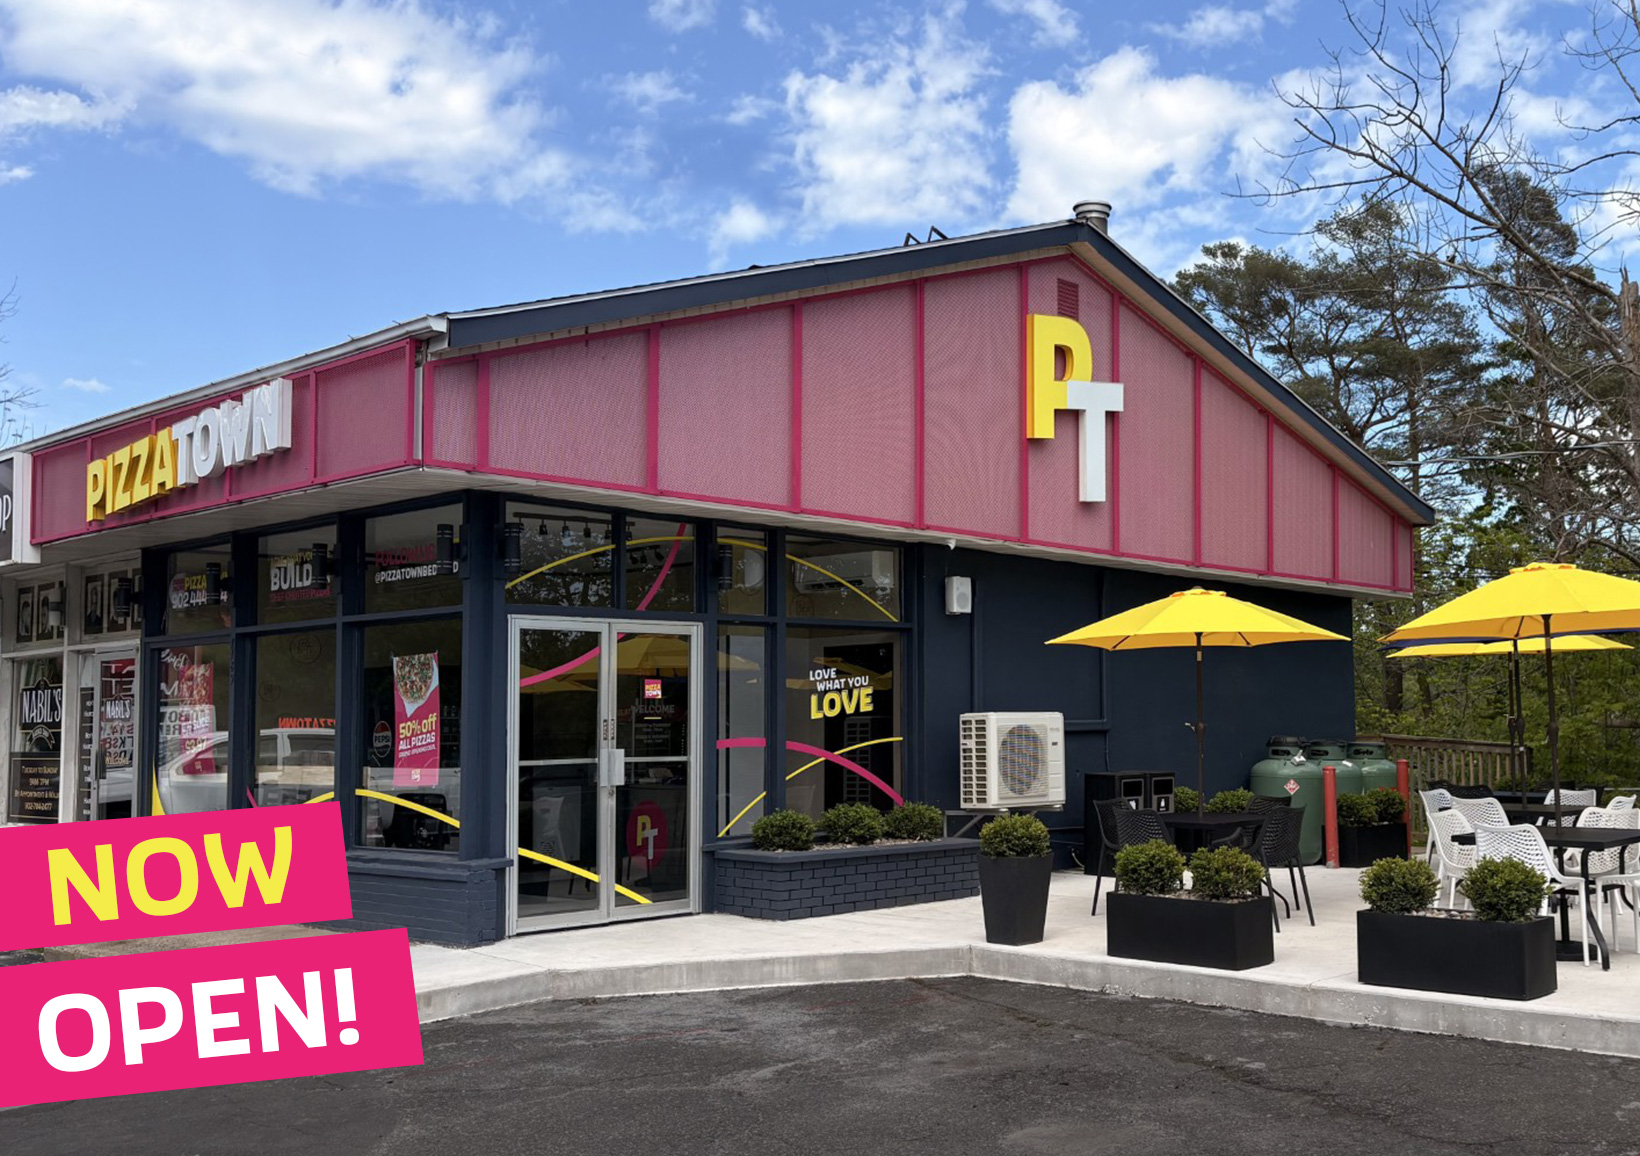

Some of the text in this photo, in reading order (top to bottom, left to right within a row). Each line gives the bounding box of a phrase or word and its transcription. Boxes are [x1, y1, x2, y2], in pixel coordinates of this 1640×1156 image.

[1027, 314, 1124, 502] PT
[270, 563, 312, 592] BUILD
[374, 561, 459, 584] @PIZZATOWNBEDD
[809, 668, 837, 681] LOVE
[816, 675, 869, 691] WHAT YOU
[22, 688, 62, 724] NABIL'S
[631, 704, 675, 714] WELCOME
[811, 686, 874, 720] LOVE
[399, 713, 437, 738] 50% off
[398, 732, 436, 750] ALL PIZZAS
[636, 815, 659, 860] PT
